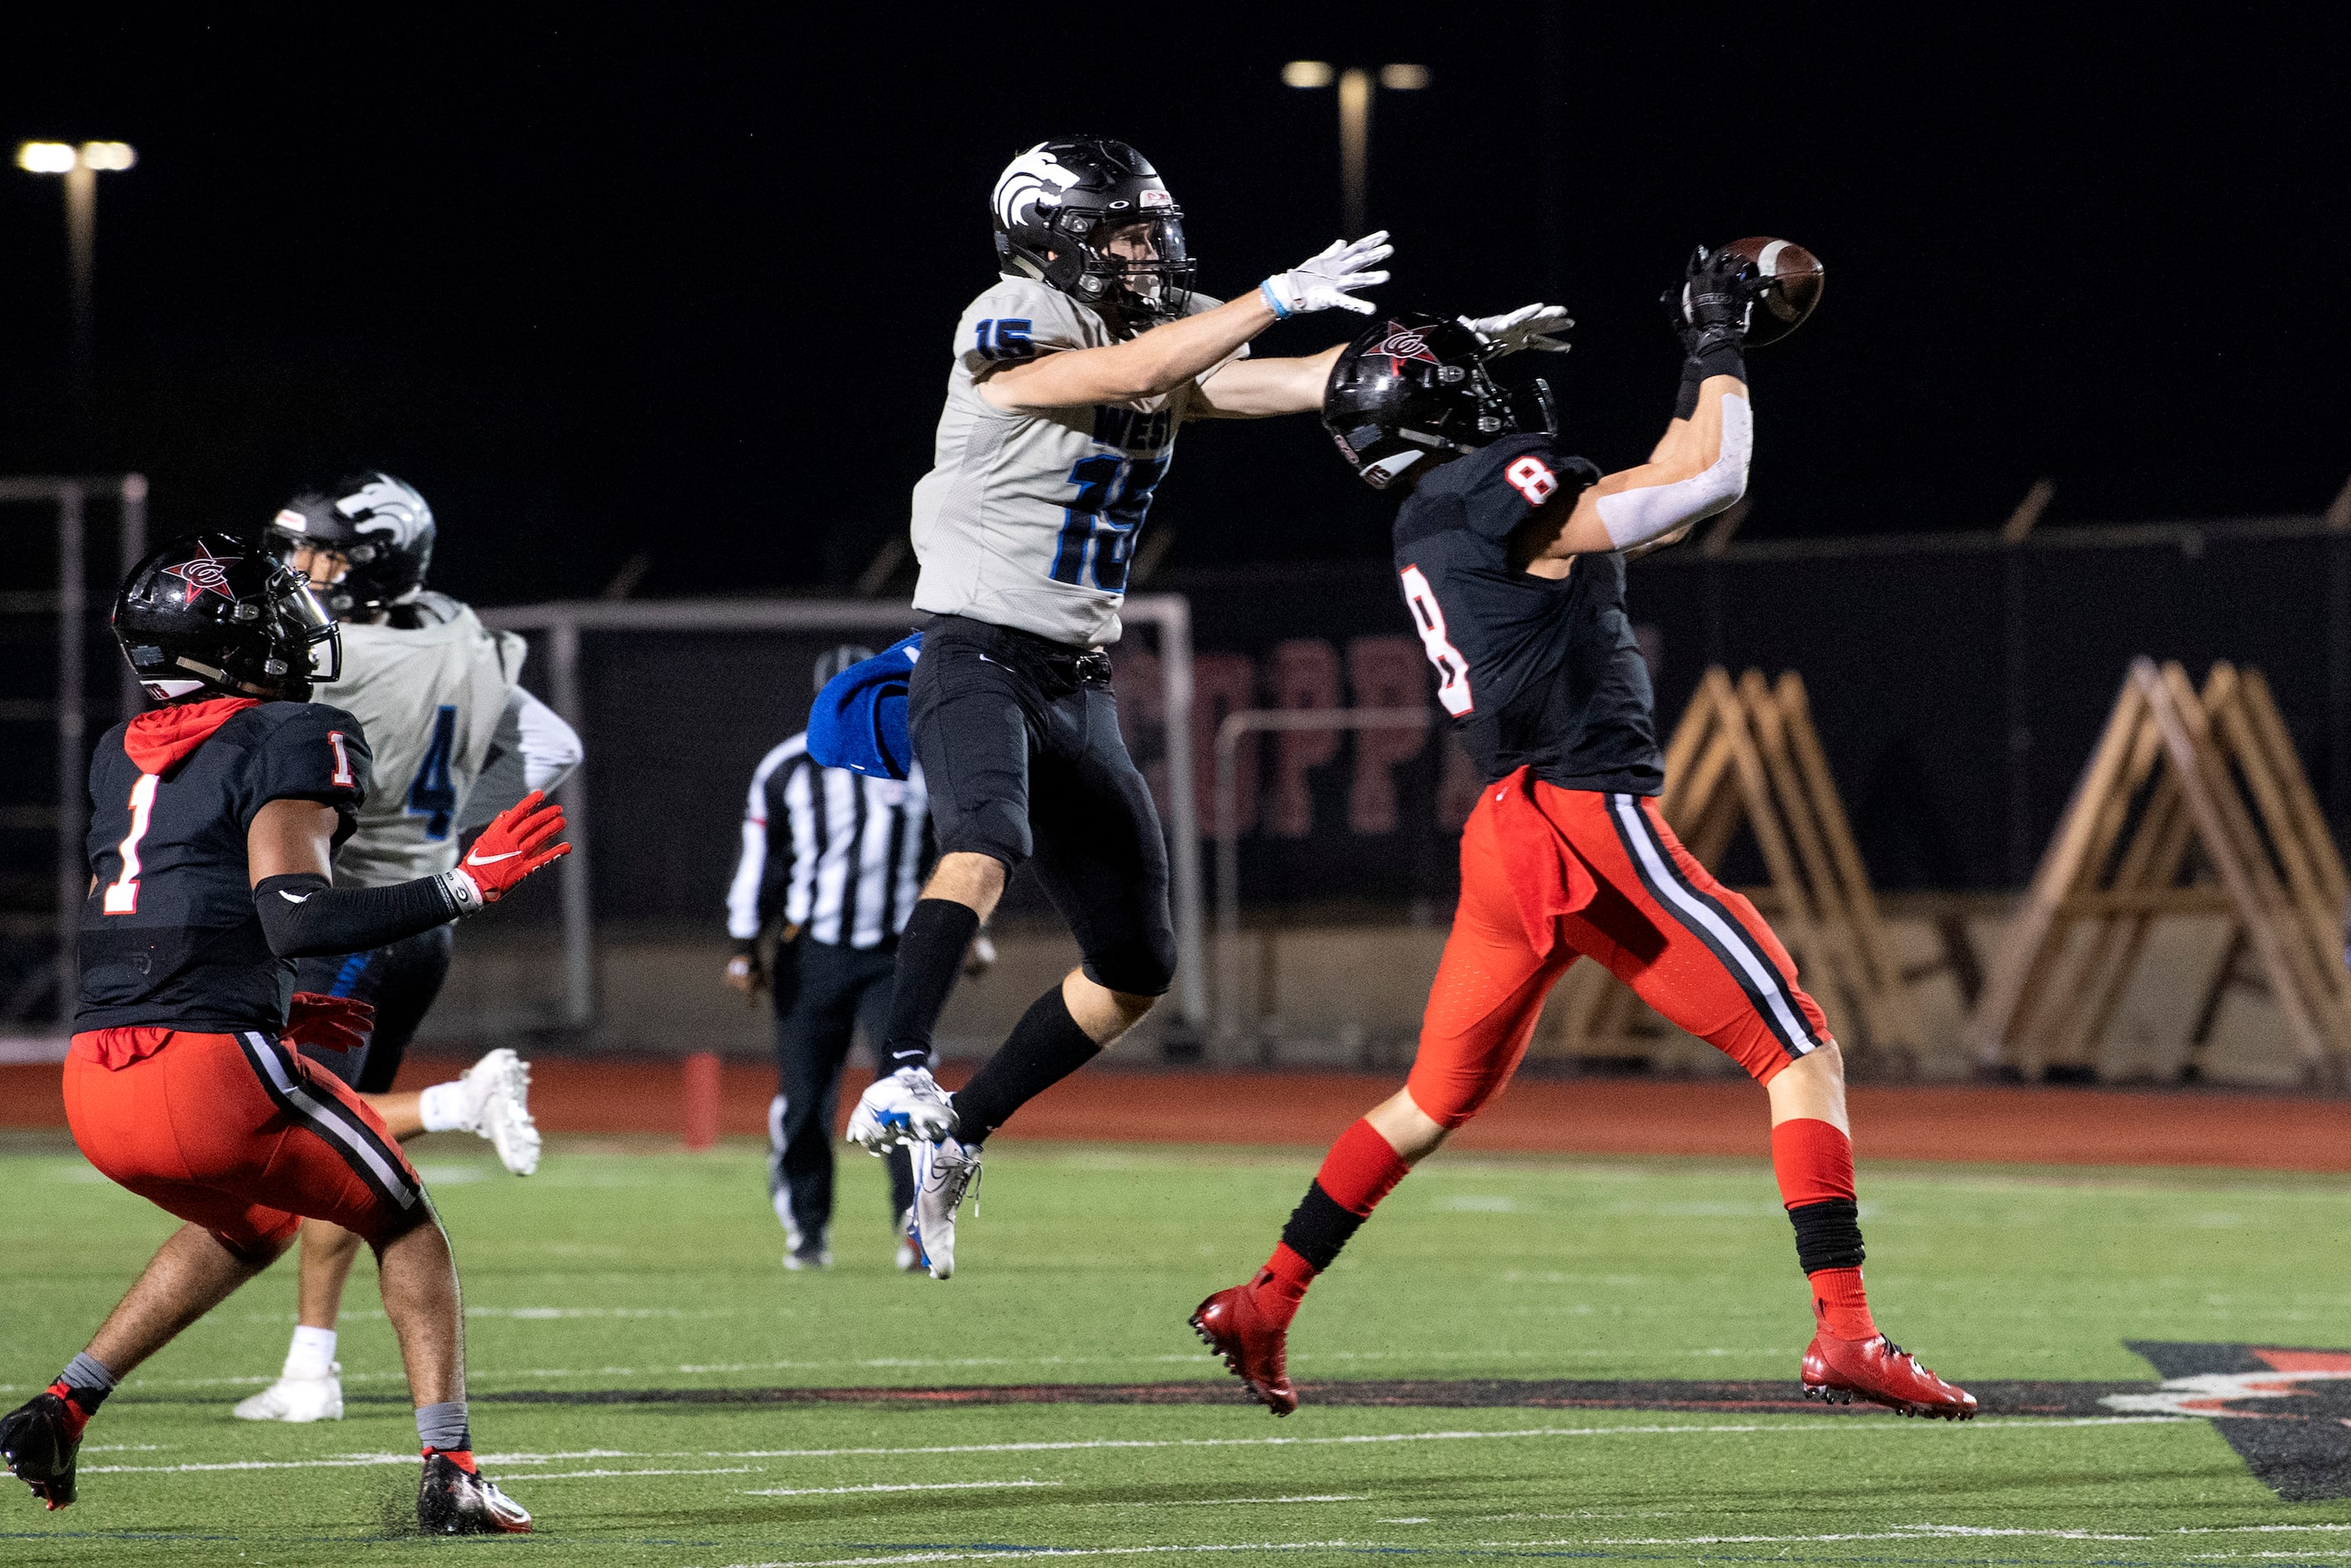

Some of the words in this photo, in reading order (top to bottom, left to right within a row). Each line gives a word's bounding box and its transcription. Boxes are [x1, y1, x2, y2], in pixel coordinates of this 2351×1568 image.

[974, 319, 1034, 360] 15
[1049, 453, 1170, 595] 15
[1505, 456, 1559, 507] 8
[1401, 564, 1474, 717] 8
[328, 731, 354, 787] 1
[408, 705, 457, 840] 4
[104, 773, 159, 915] 1
